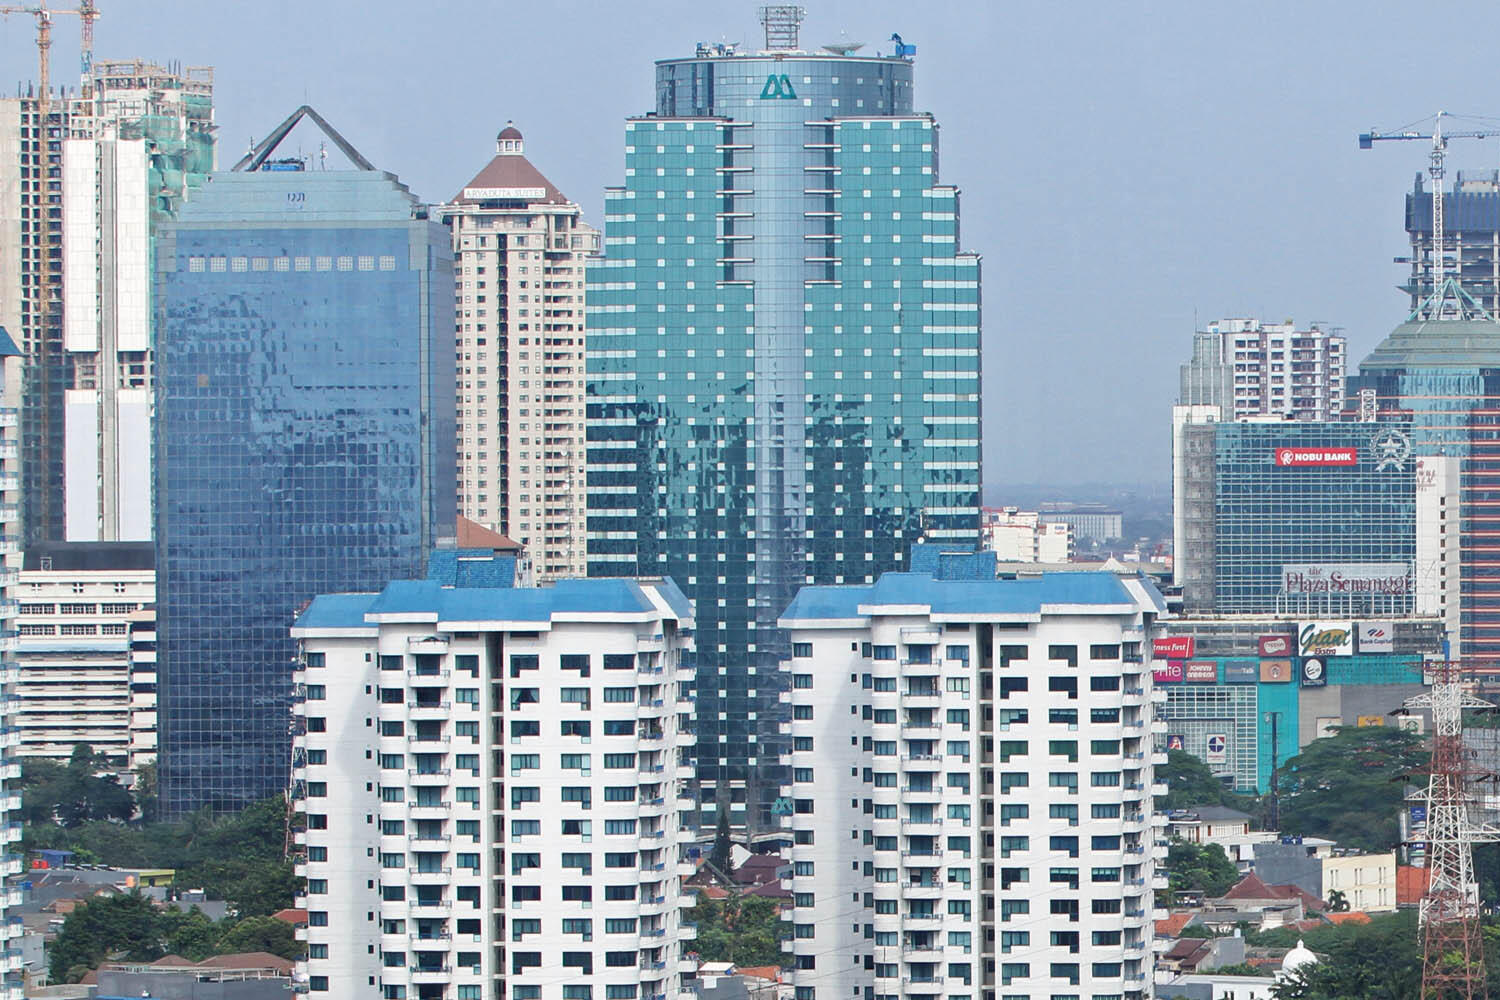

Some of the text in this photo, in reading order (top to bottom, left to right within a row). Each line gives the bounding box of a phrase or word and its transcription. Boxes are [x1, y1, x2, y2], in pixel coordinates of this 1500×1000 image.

[466, 189, 545, 197] ARYADUTA SUITES
[1286, 571, 1411, 595] Plaza Semanggi
[1172, 643, 1186, 651] first
[1300, 624, 1351, 655] Giant
